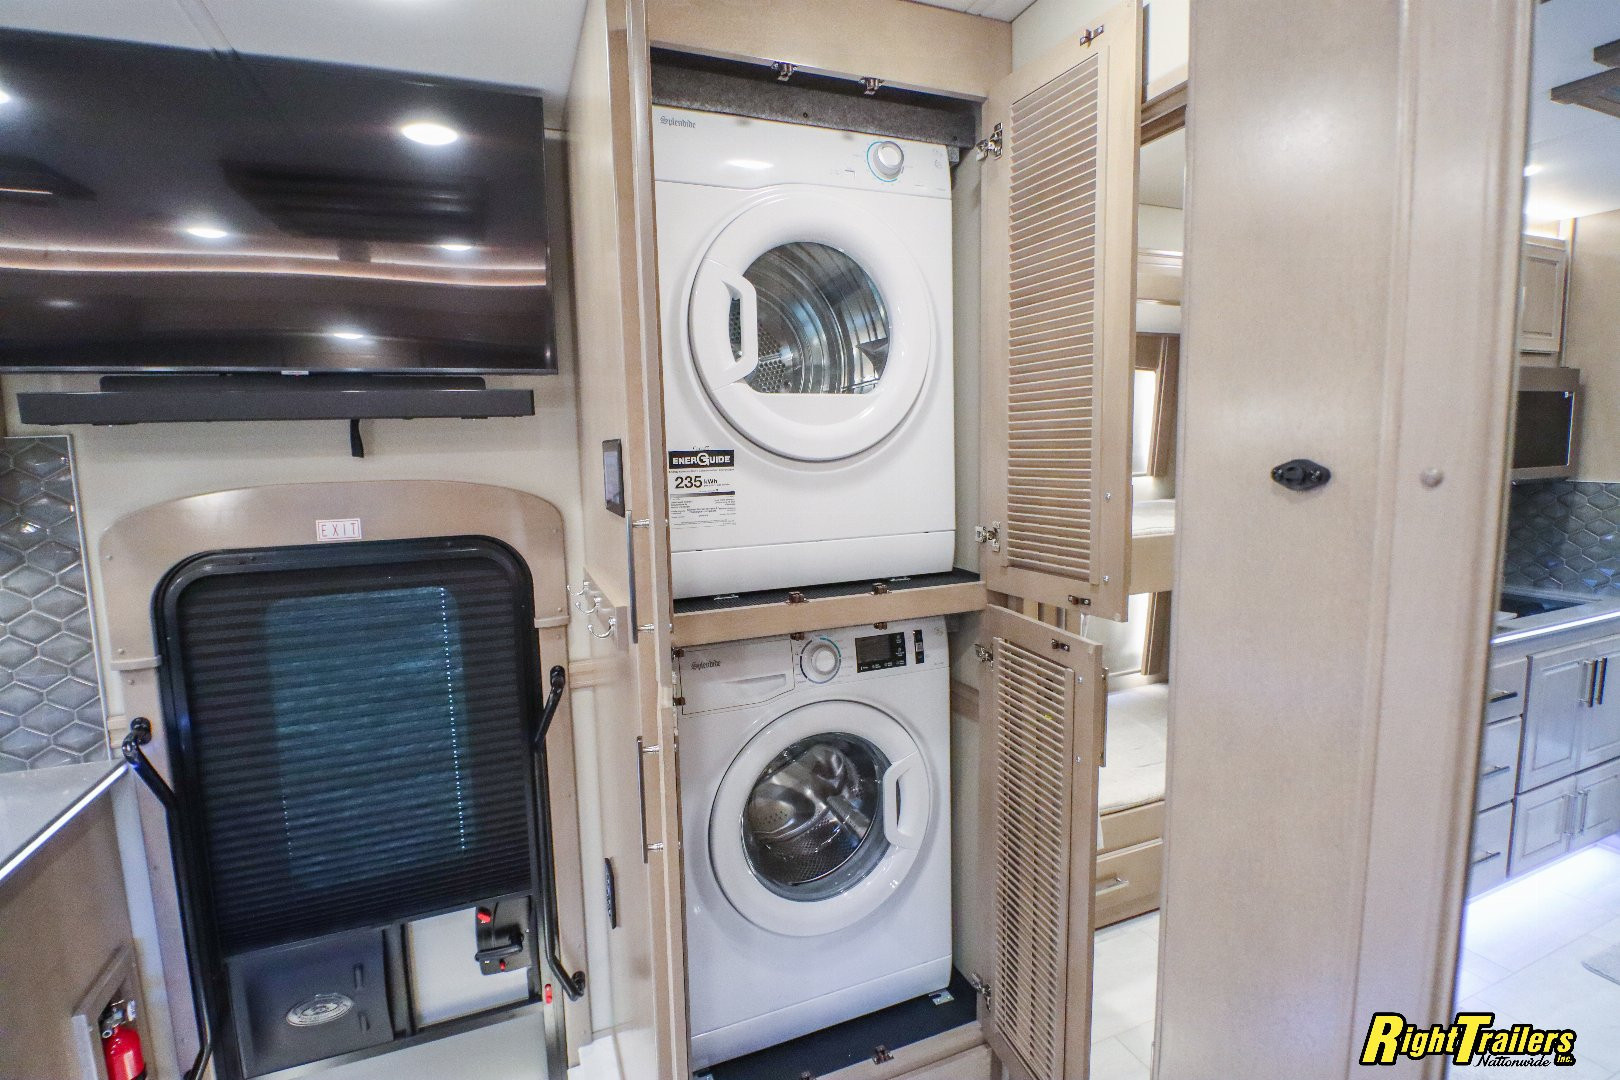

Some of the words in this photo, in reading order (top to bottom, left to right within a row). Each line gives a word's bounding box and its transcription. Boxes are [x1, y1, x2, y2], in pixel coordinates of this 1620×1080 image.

[660, 116, 696, 128] Splendide
[675, 475, 703, 489] 235
[321, 523, 357, 537] EXIT
